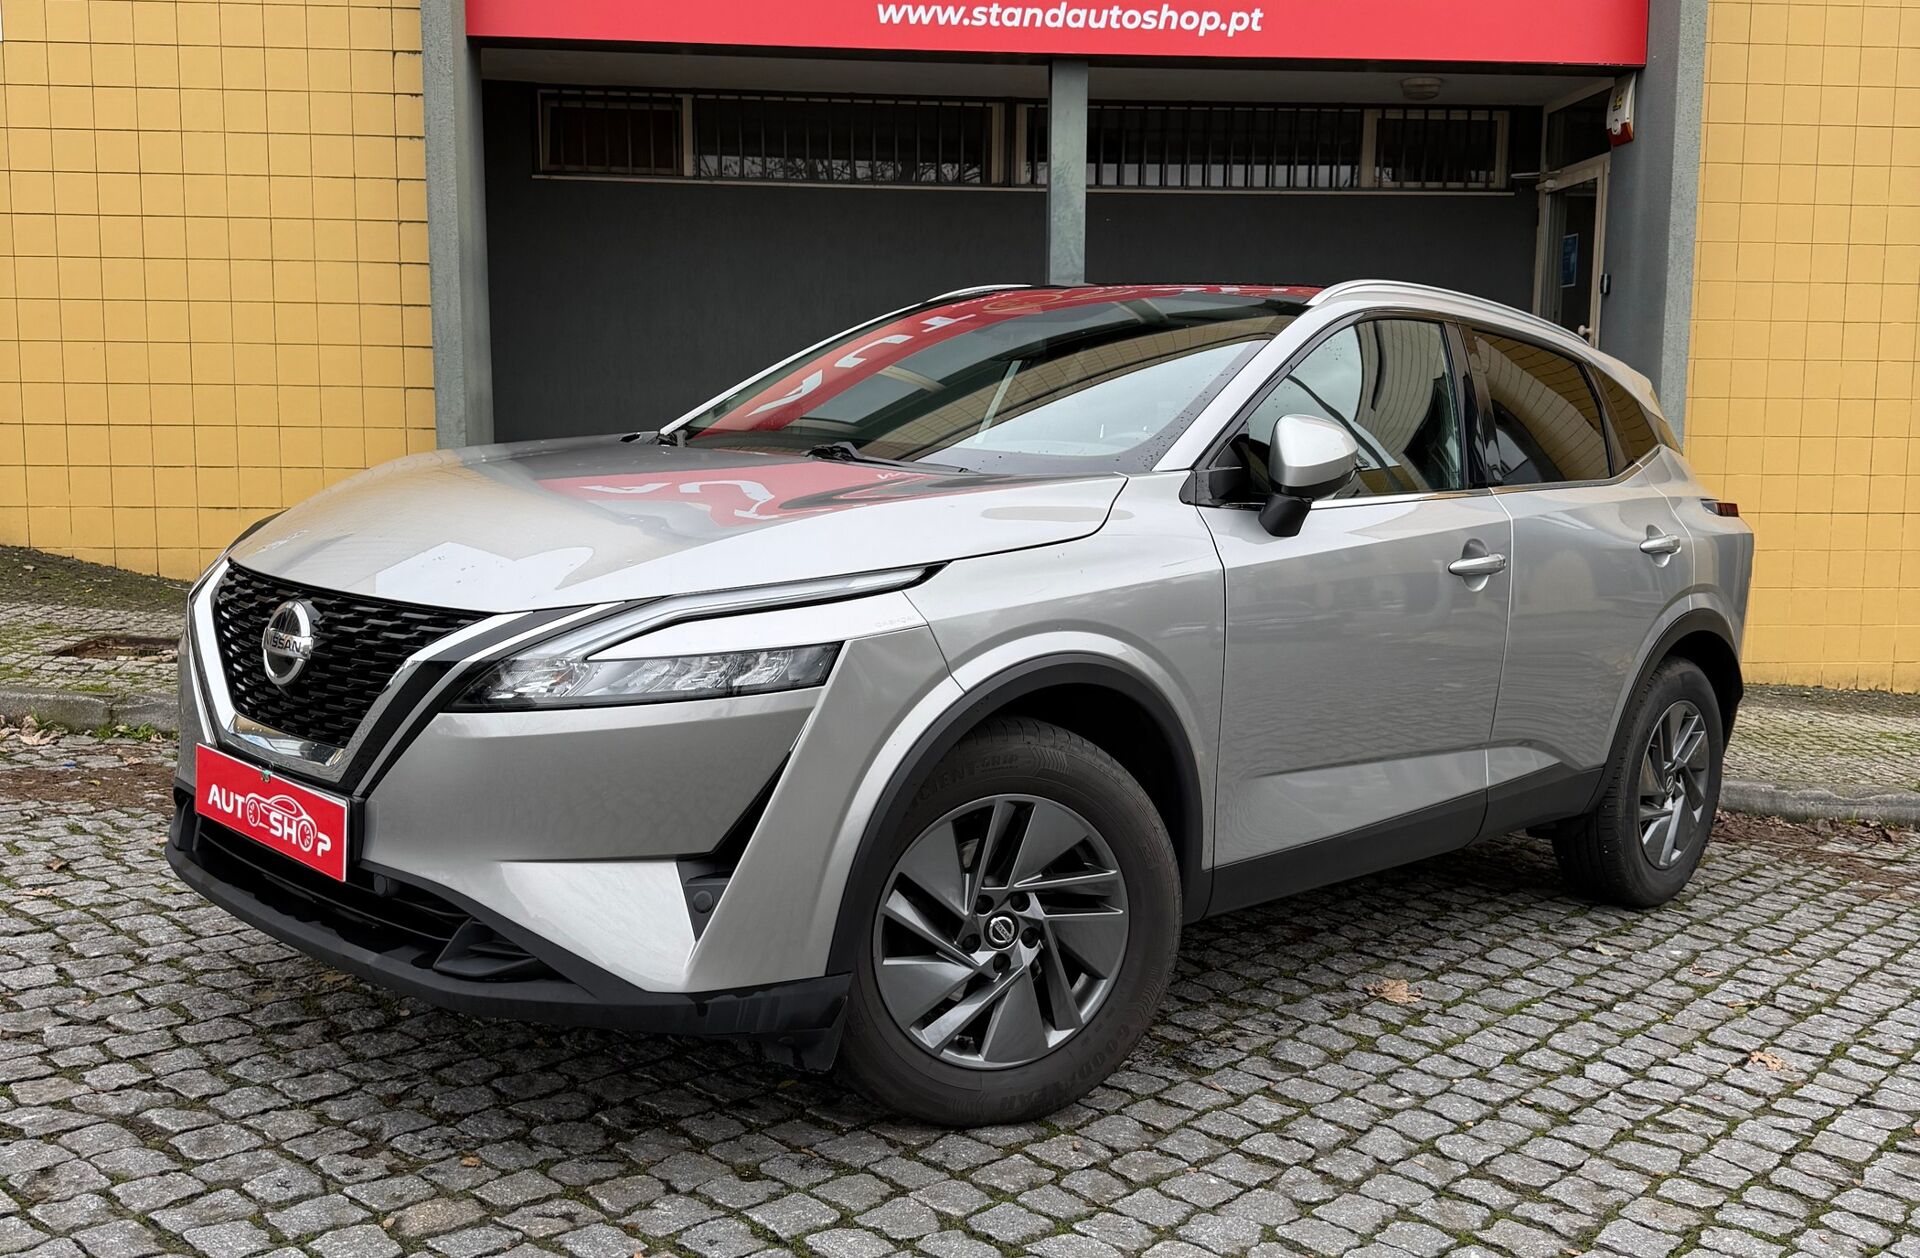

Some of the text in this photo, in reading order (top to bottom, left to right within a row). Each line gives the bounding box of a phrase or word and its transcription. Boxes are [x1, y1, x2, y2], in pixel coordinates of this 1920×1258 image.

[877, 2, 1264, 37] www.standautoshop.pt
[266, 630, 302, 654] NISSAN
[269, 811, 332, 857] SHOP
